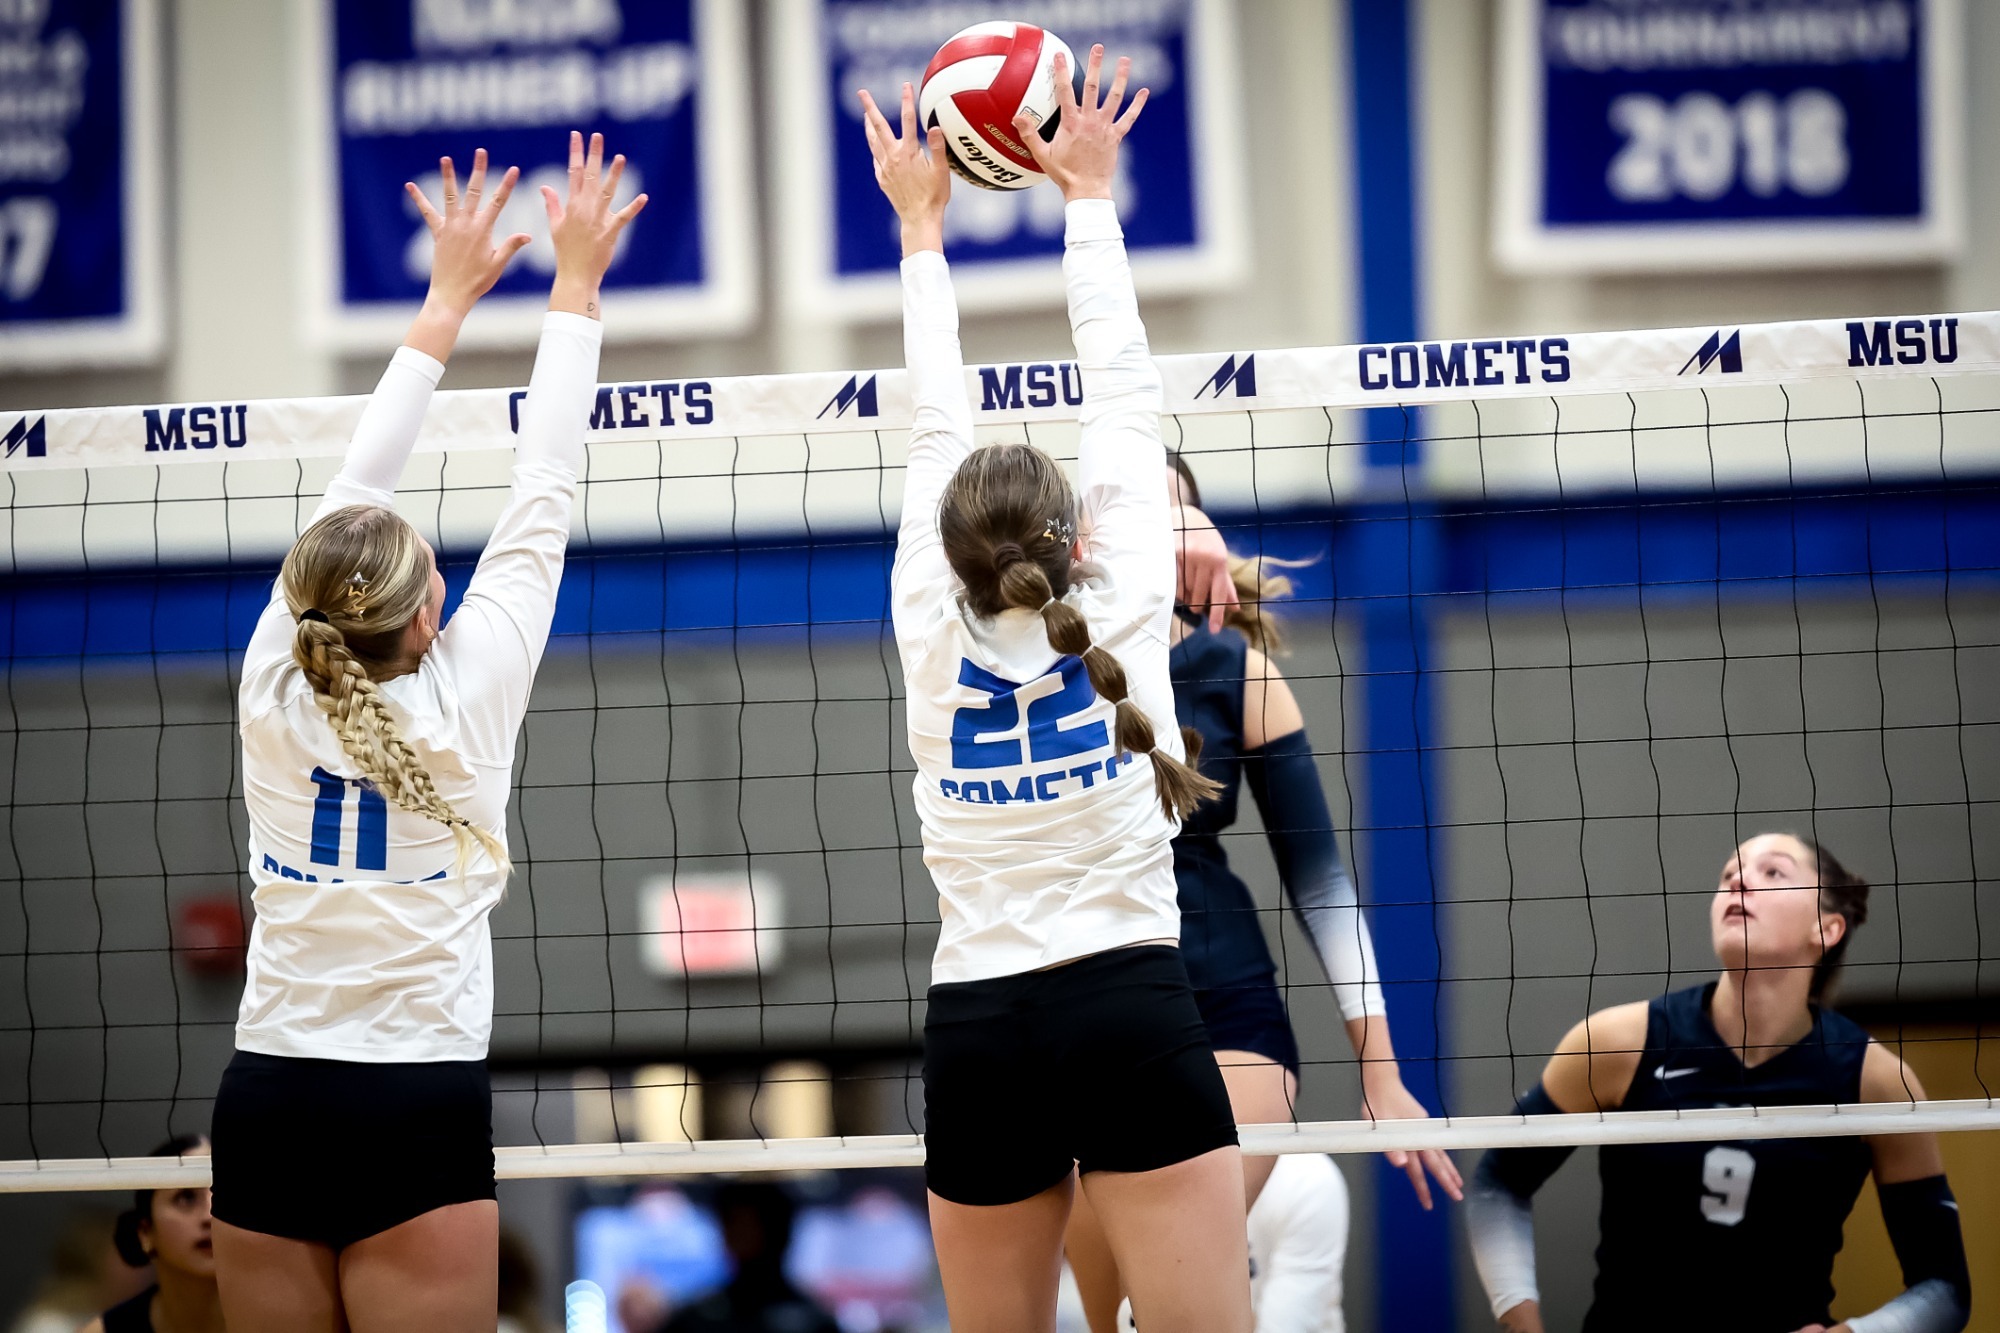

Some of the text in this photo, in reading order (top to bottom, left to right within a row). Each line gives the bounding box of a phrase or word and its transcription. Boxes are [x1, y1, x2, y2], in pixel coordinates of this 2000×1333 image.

[957, 136, 1024, 183] Baden
[1606, 89, 1850, 202] 2018
[142, 404, 248, 452] MSU
[508, 381, 714, 434] CMETS
[978, 363, 1084, 411] MSU
[1358, 337, 1571, 391] COMETS
[1845, 317, 1959, 368] MSU
[949, 654, 1110, 770] 22
[309, 765, 388, 871] 11
[1700, 1145, 1757, 1227] 9
